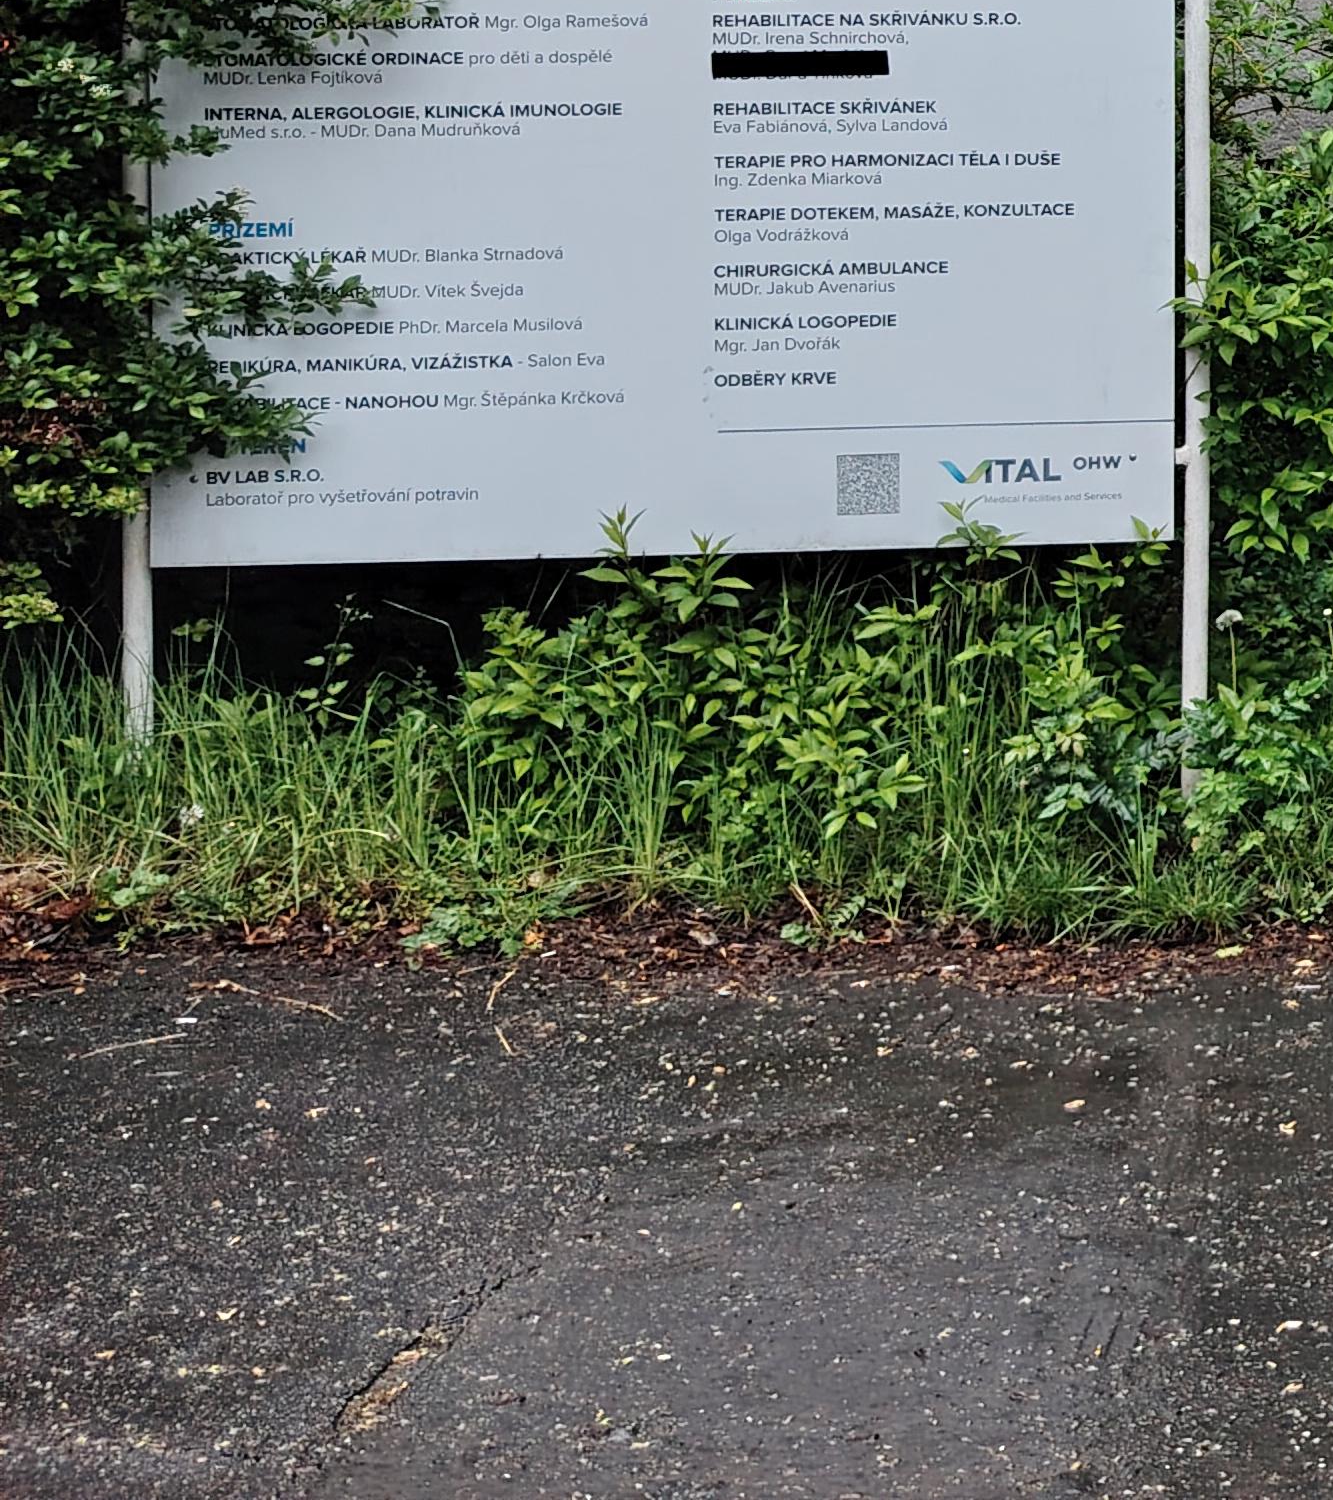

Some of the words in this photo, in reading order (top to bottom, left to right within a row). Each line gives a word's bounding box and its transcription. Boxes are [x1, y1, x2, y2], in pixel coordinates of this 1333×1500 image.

[486, 16, 518, 32] Mgr.
[524, 15, 560, 31] Olga
[566, 13, 648, 27] Ramešová
[713, 14, 834, 27] REHABILITACE
[840, 14, 864, 26] NA
[870, 10, 967, 26] SKŘIVÁNKU
[973, 13, 1021, 25] S.R.O.
[713, 32, 760, 45] MUDr.
[766, 32, 804, 44] Irena
[809, 31, 908, 45] Schnirchová,
[372, 52, 463, 65] ORDINACE
[469, 55, 495, 68] pro
[500, 51, 529, 64] děti
[535, 54, 543, 64] a
[549, 49, 612, 66] dospělé
[204, 72, 253, 85] MUDr.
[257, 69, 305, 85] Lenka
[310, 67, 382, 87] Fojtíková
[205, 108, 287, 121] INTERNA,
[292, 106, 419, 120] ALERGOLOGIE,
[425, 102, 505, 118] KLINICKÁ
[510, 103, 622, 117] IMUNOLOGIE
[714, 102, 835, 115] REHABILITACE
[840, 98, 936, 114] SKŘIVÁNEK
[213, 124, 266, 141] uMed
[271, 128, 306, 138] s.r.o.
[321, 124, 369, 138] MUDr.
[375, 124, 415, 137] Dana
[422, 122, 520, 136] Mudruňková
[714, 121, 741, 133] Eva
[747, 119, 831, 134] Fabiánová,
[837, 119, 876, 135] Sylva
[882, 118, 947, 131] Landová
[714, 155, 785, 168] TERAPIE
[791, 155, 826, 167] PRO
[832, 154, 953, 166] HARMONIZACI
[959, 151, 1000, 166] TĚLA
[1015, 150, 1060, 165] DUŠE
[715, 174, 742, 190] Ing.
[748, 173, 806, 186] Zdenka
[812, 171, 881, 185] Miarková
[715, 208, 785, 221] TERAPIE
[791, 207, 878, 220] DOTEKEM,
[885, 202, 959, 219] MASÁŽE,
[964, 203, 1074, 217] KONZULTACE
[714, 230, 751, 245] Olga
[756, 228, 848, 241] Vodrážková
[215, 248, 307, 267] AKTICKÝ
[372, 250, 419, 263] MUDr.
[426, 249, 478, 262] Blanka
[484, 246, 563, 261] Strnadová
[714, 260, 834, 278] CHIRURGICKÁ
[839, 261, 948, 275] AMBULANCE
[370, 283, 422, 300] MUDr.
[425, 284, 465, 297] Vítek
[471, 281, 523, 300] Švejda
[714, 282, 761, 295] MUDr.
[766, 281, 814, 294] Jakub
[818, 280, 895, 293] Avenarius
[399, 321, 440, 334] PhDr.
[446, 320, 507, 333] Marcela
[514, 316, 582, 331] Musilová
[715, 313, 793, 330] KLINICKÁ
[799, 314, 896, 328] LOGOPEDIE
[715, 340, 746, 355] Mgr.
[752, 339, 779, 351] Jan
[785, 336, 840, 350] Dvořák
[208, 355, 302, 374] PEIKÚRA,
[307, 355, 406, 372] MANIKÚRA,
[411, 353, 512, 369] VIZÁŽISTKA
[528, 354, 571, 367] Salon
[577, 353, 604, 366] Eva
[714, 370, 786, 387] ODBĚRY
[792, 372, 836, 385] KRVE
[346, 395, 438, 409] NANOHOU
[444, 394, 476, 410] Mgr.
[481, 391, 556, 408] Štěpánka
[562, 389, 624, 404] Krčková
[1072, 455, 1122, 471] OHW
[206, 471, 231, 484] BV
[236, 470, 269, 483] LAB
[274, 469, 323, 482] S.R.O.
[205, 488, 283, 507] Laboratoř
[288, 494, 314, 507] pro
[319, 488, 411, 506] vyšetřování
[415, 488, 478, 504] potravin
[1064, 491, 1081, 501] and
[1083, 491, 1123, 501] Services
